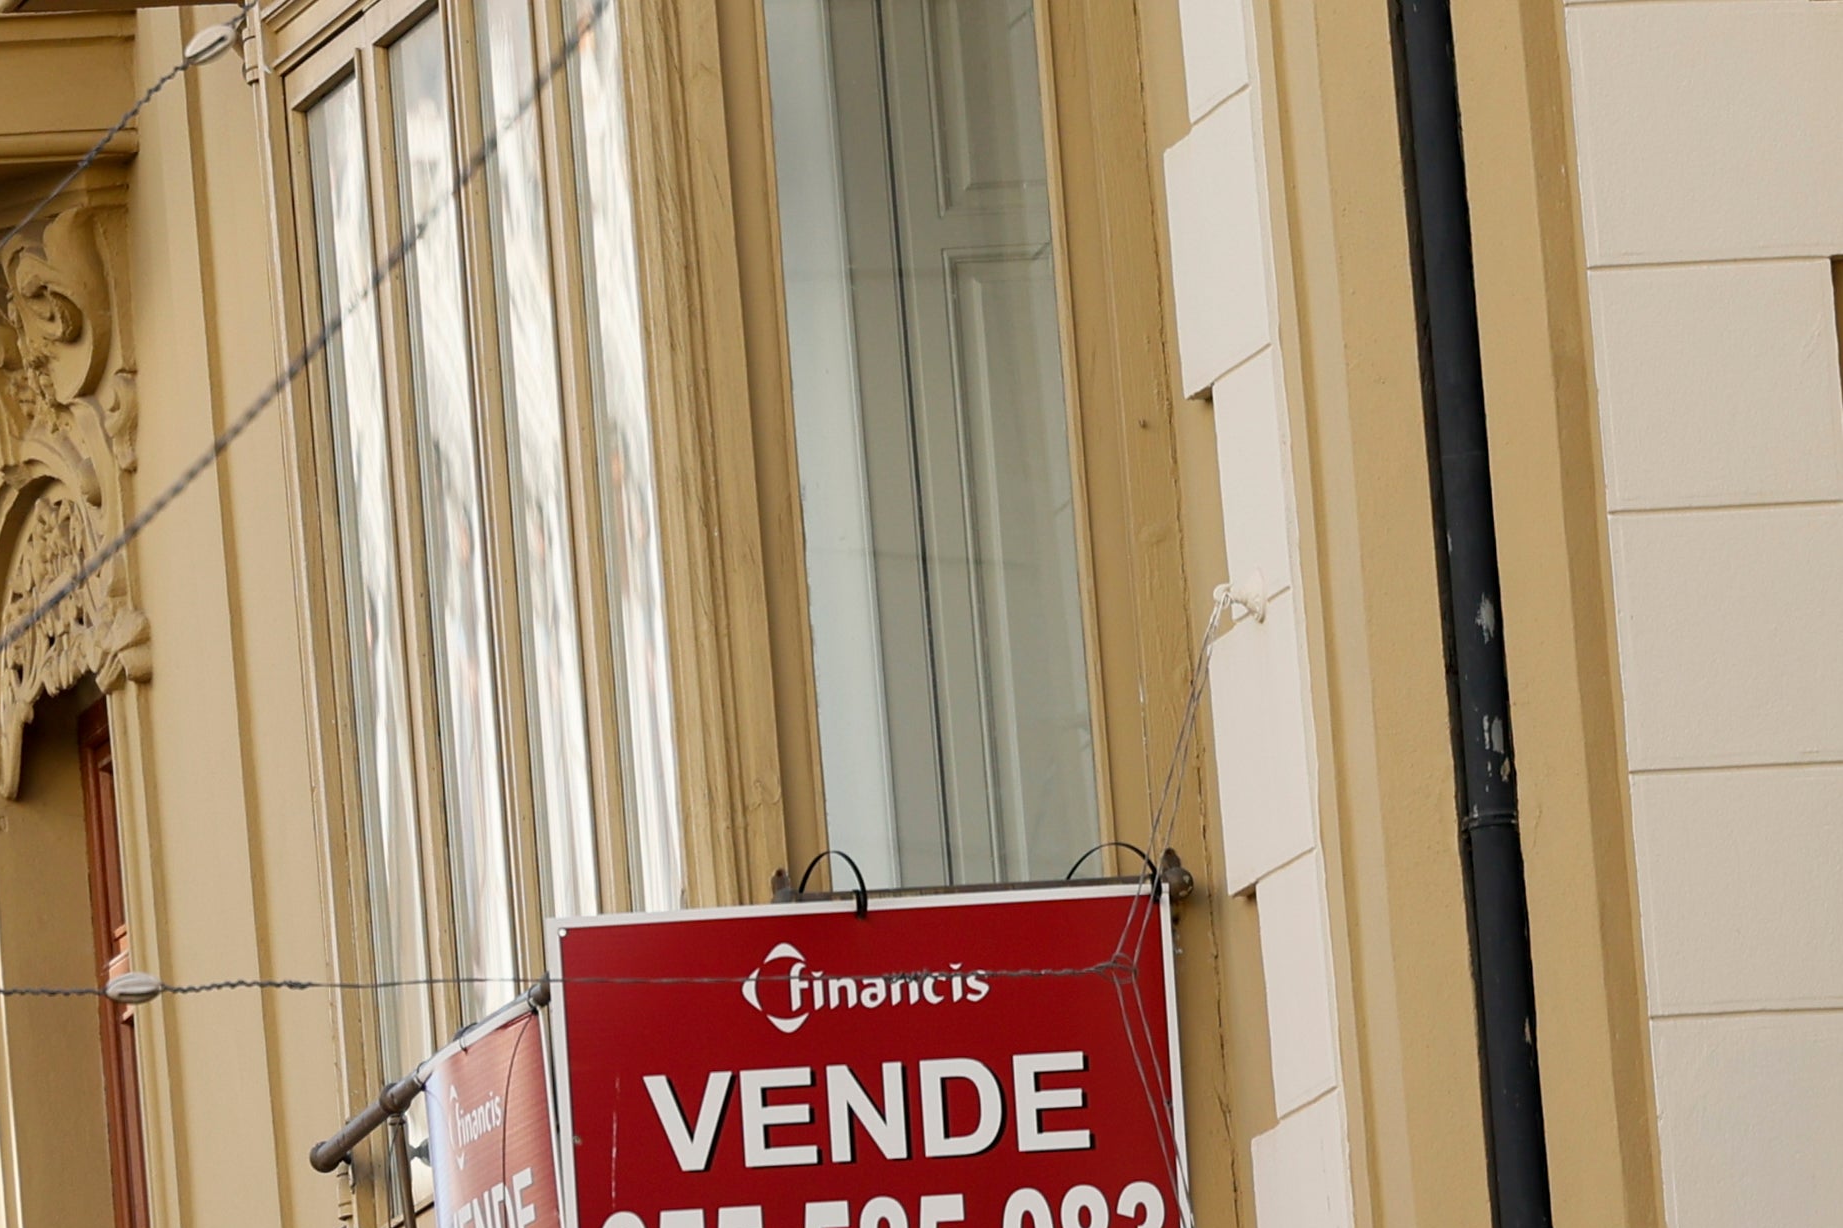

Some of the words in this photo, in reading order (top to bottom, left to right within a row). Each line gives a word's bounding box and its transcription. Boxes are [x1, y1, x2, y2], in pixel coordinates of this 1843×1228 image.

[788, 960, 991, 1014] financis
[456, 1090, 504, 1151] financis
[643, 1051, 1093, 1172] VENDE
